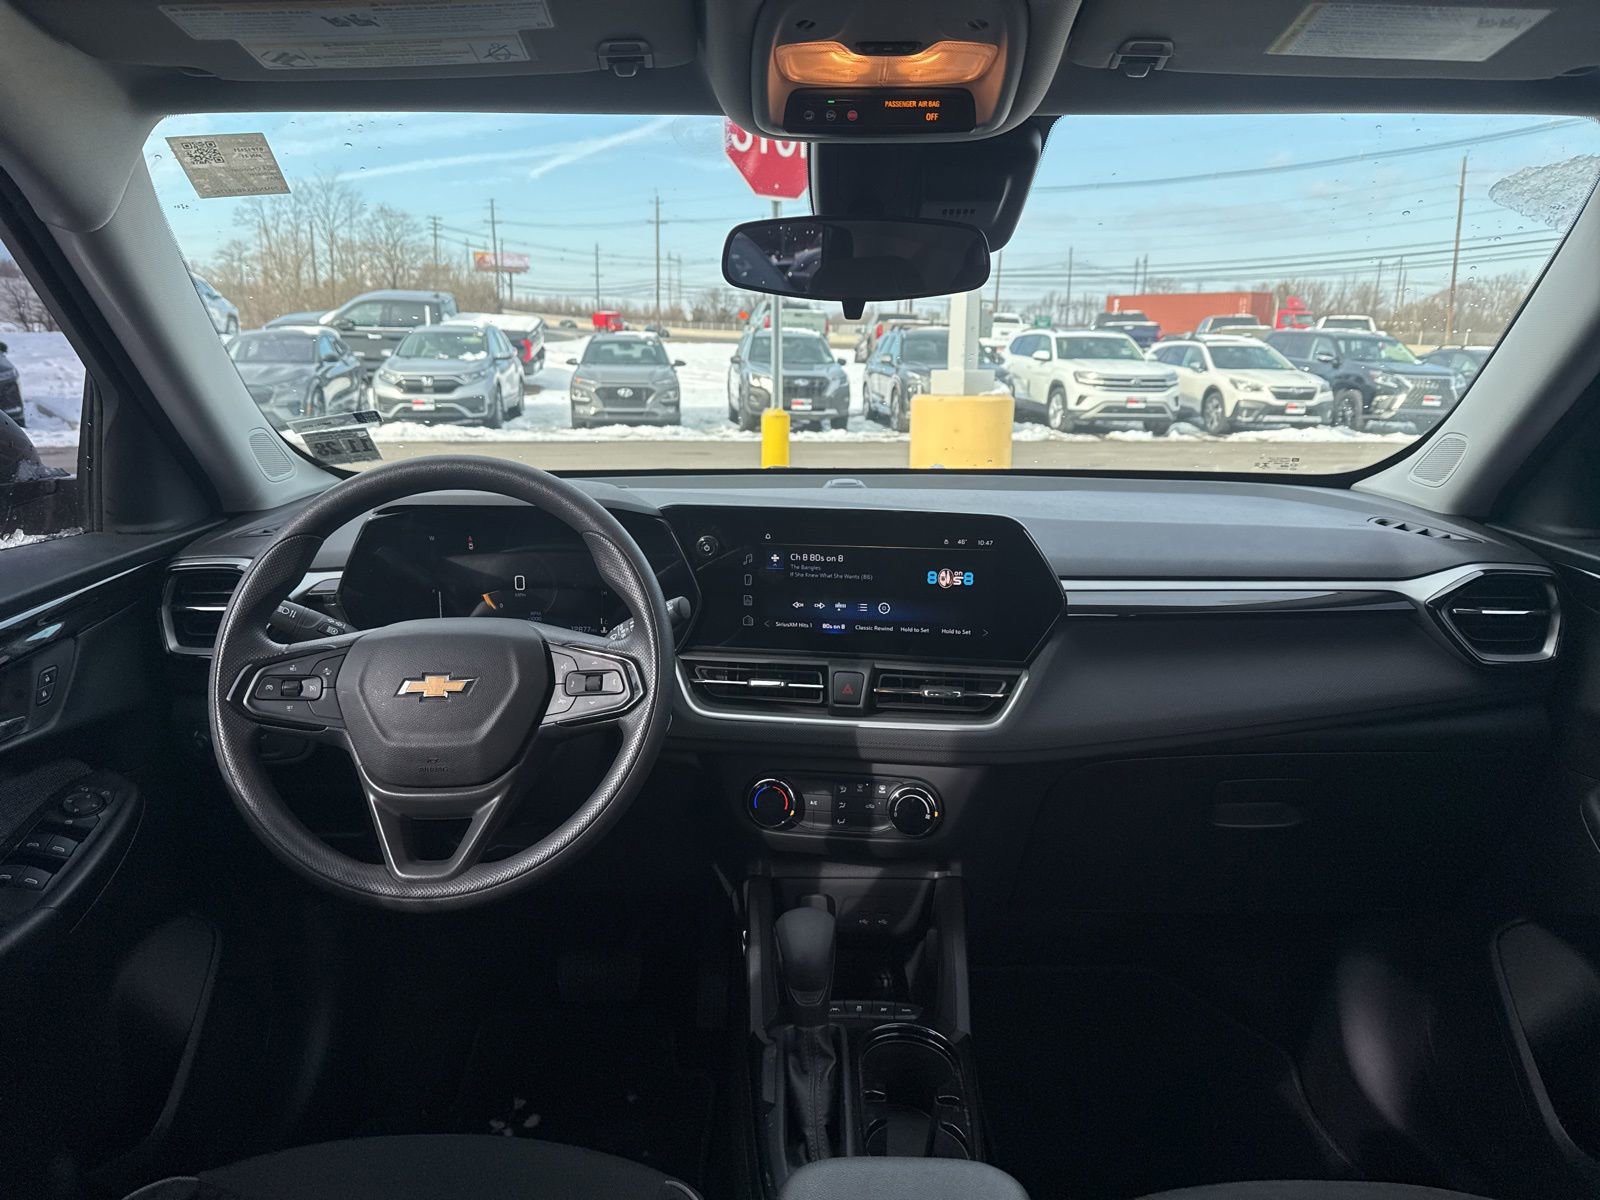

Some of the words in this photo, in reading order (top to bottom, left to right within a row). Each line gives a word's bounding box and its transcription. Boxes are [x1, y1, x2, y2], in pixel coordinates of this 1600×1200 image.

[884, 100, 917, 108] PASSENGER
[918, 100, 928, 108] AIR
[928, 100, 940, 108] BAG
[925, 112, 939, 121] OFF
[790, 553, 801, 561] Ch
[802, 553, 808, 561] 8
[809, 554, 825, 562] 80s
[837, 554, 844, 563] 8
[514, 575, 526, 591] 0
[963, 571, 974, 586] 8
